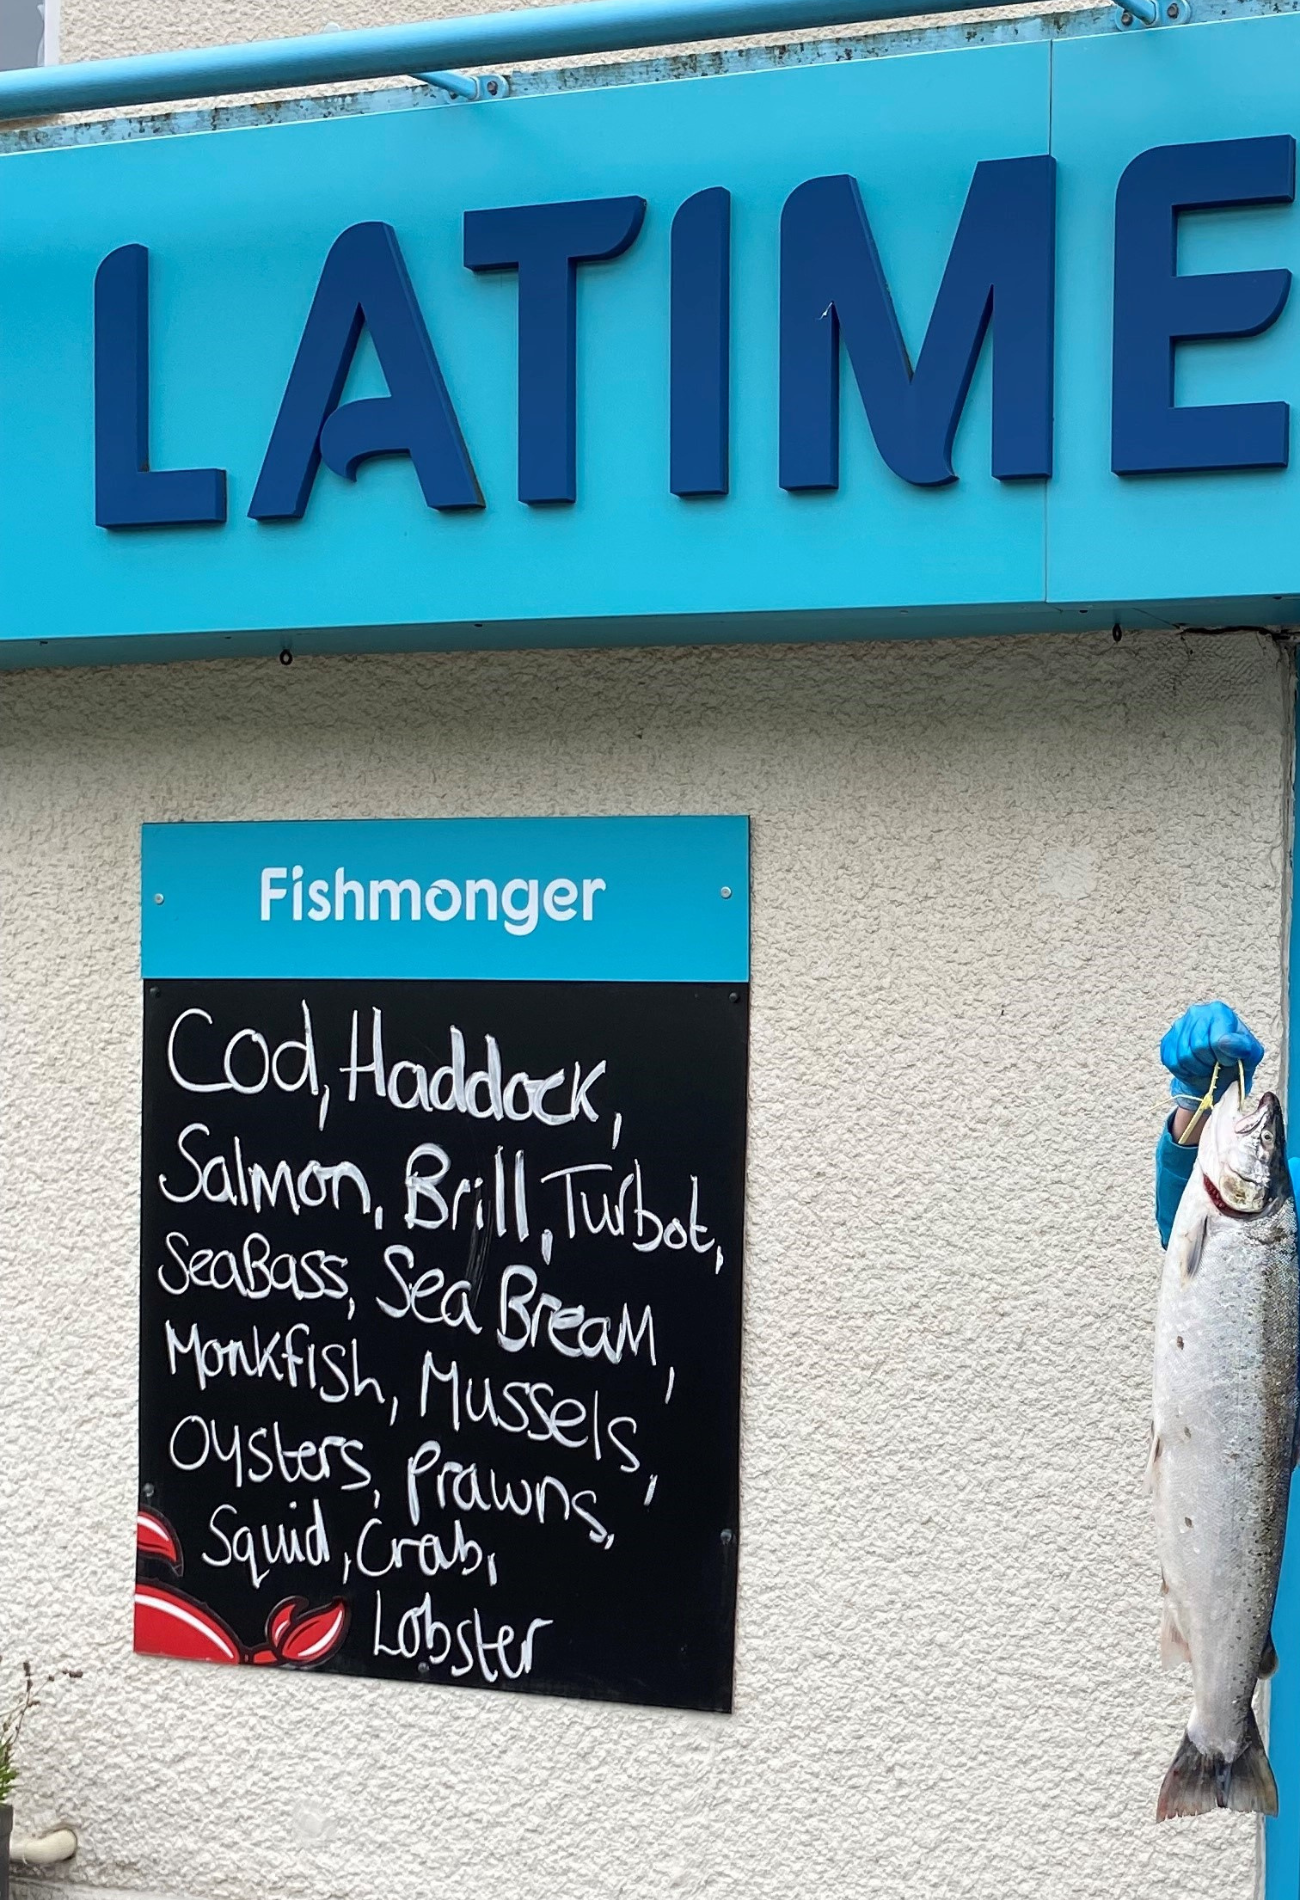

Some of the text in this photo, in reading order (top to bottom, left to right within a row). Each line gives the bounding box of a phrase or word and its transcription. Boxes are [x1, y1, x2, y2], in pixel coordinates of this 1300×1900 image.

[260, 865, 606, 935] Fishmonger
[168, 999, 623, 1149] Cod, Haddock,
[159, 1123, 724, 1275] Salmon, Brill, Turbot,
[376, 1245, 483, 1334] Sea
[165, 1320, 658, 1506] Monkfish, Mussels,
[169, 1415, 380, 1508] Oysters,
[372, 1590, 554, 1682] Lobster
